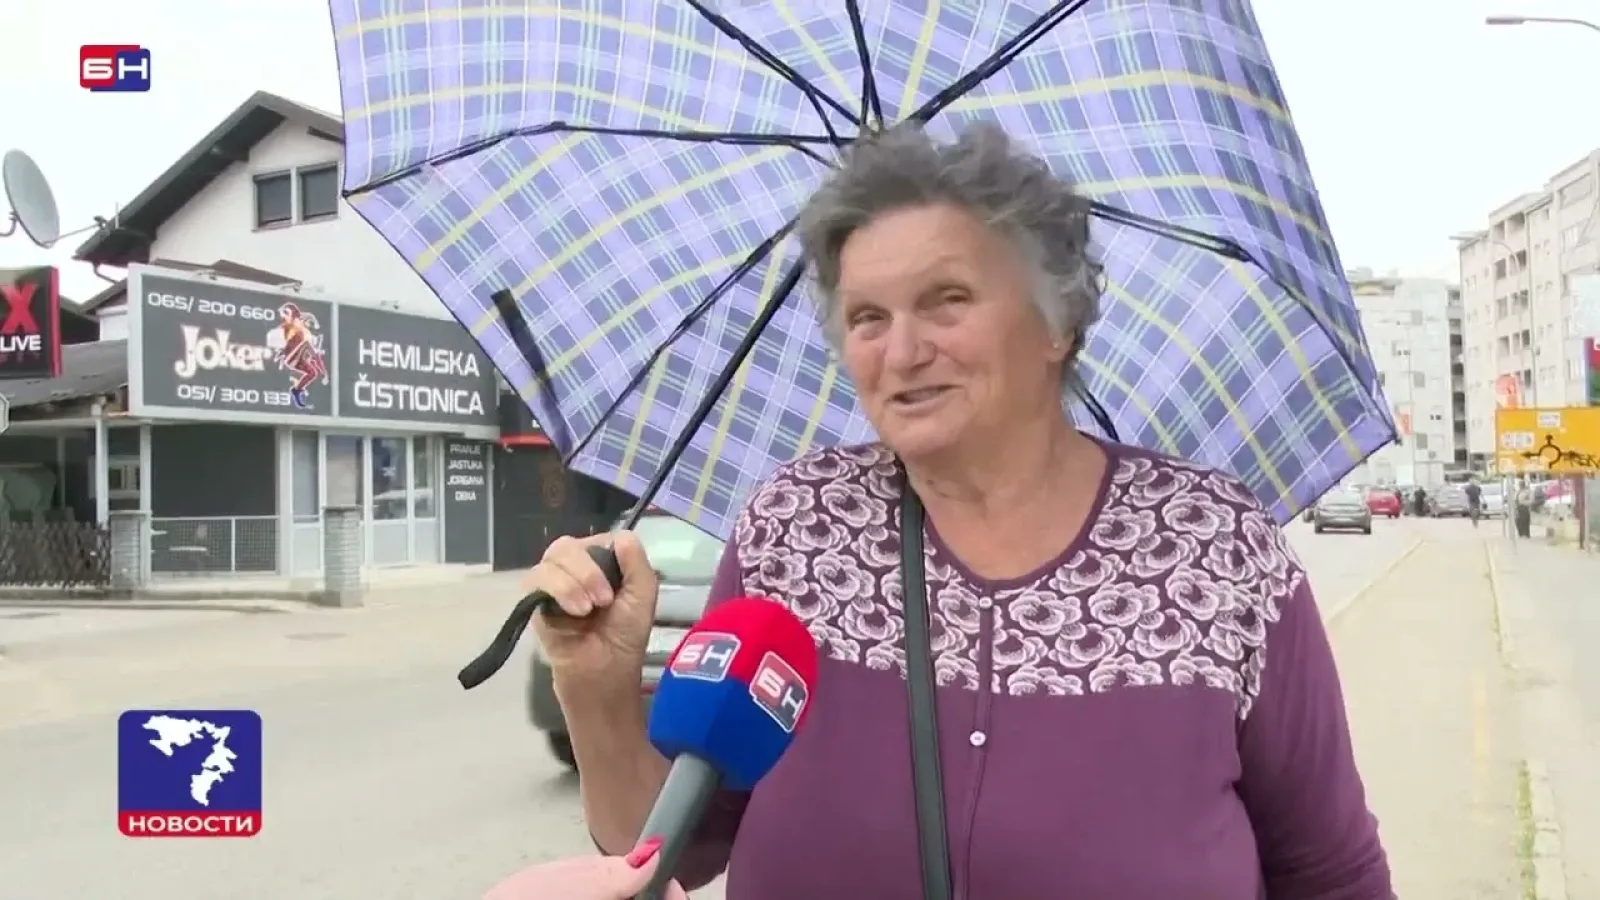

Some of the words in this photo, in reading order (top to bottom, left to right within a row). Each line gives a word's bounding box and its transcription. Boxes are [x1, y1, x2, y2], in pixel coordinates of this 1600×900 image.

[147, 292, 194, 313] 065/
[198, 299, 236, 316] 200
[240, 305, 275, 321] 660
[0, 334, 42, 352] LIVE
[174, 324, 272, 379] Joker
[358, 338, 480, 378] HEMIJSKA
[177, 384, 217, 404] 051/
[220, 388, 259, 403] 300
[263, 390, 292, 406] 133
[353, 373, 485, 416] ČISTIONICA
